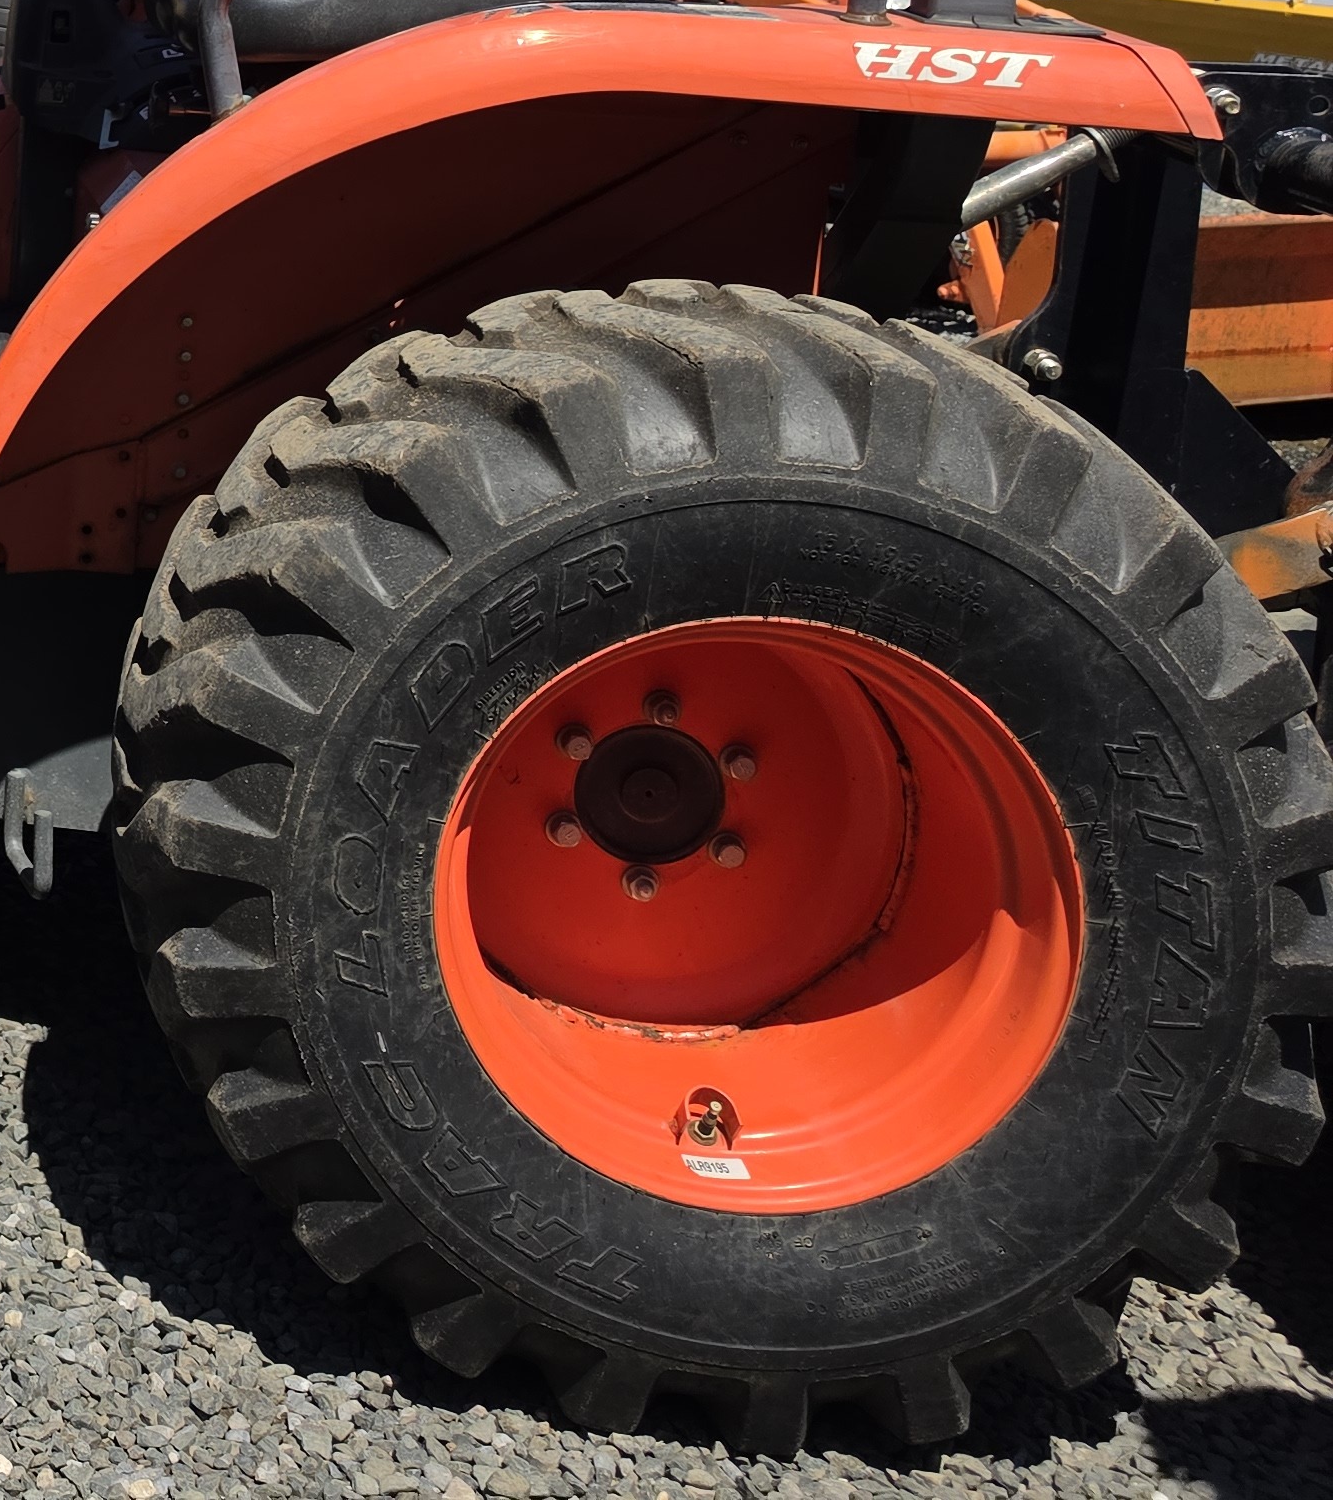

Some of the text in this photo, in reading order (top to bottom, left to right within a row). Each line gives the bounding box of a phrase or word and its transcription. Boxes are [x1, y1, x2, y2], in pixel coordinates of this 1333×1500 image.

[853, 41, 1055, 89] HST
[1254, 52, 1333, 72] META
[333, 542, 632, 998] LOADER
[1104, 731, 1216, 1141] TITAN
[685, 1158, 731, 1175] ALR9195
